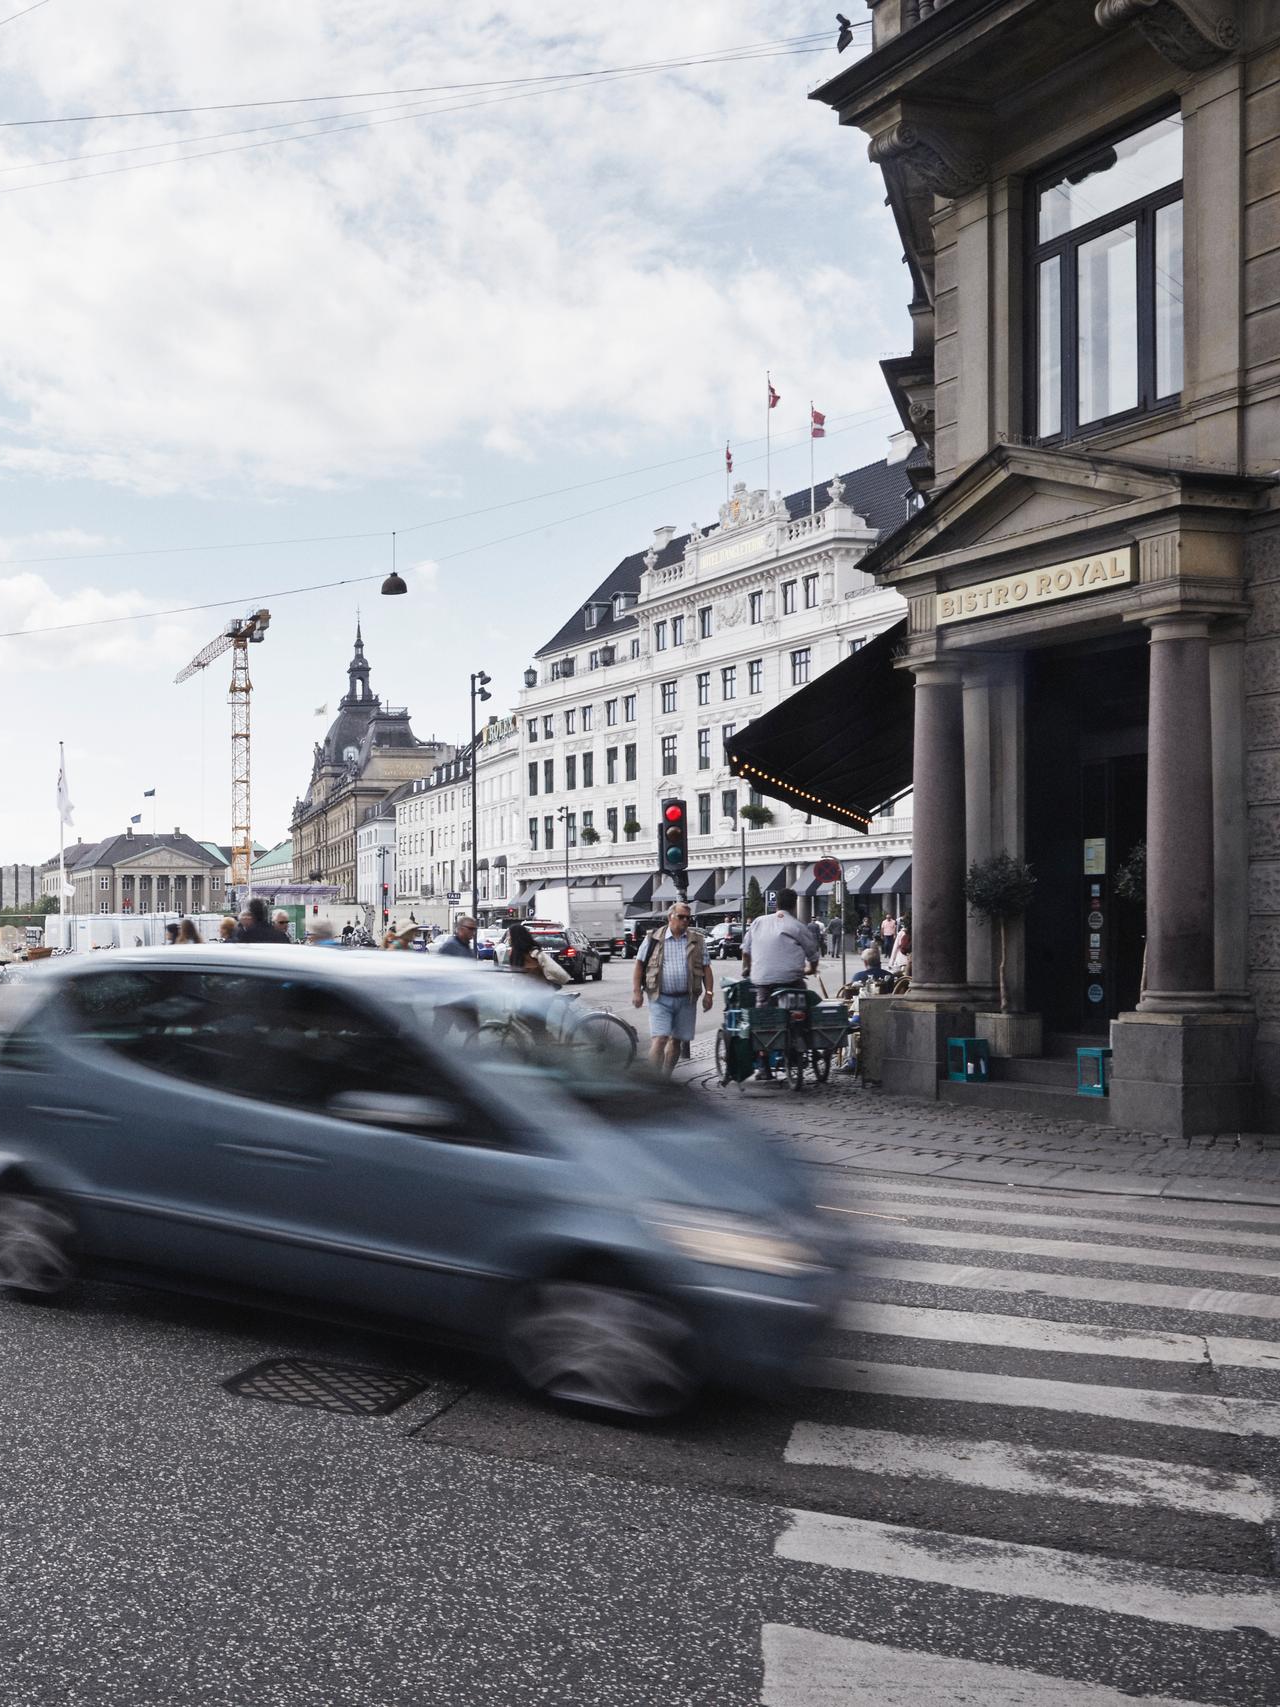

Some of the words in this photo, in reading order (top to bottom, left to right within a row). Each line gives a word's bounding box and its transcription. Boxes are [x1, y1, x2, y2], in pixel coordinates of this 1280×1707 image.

[941, 581, 1029, 619] BISTRO
[1035, 557, 1125, 596] ROYAL
[769, 892, 776, 901] P
[528, 908, 534, 917] P
